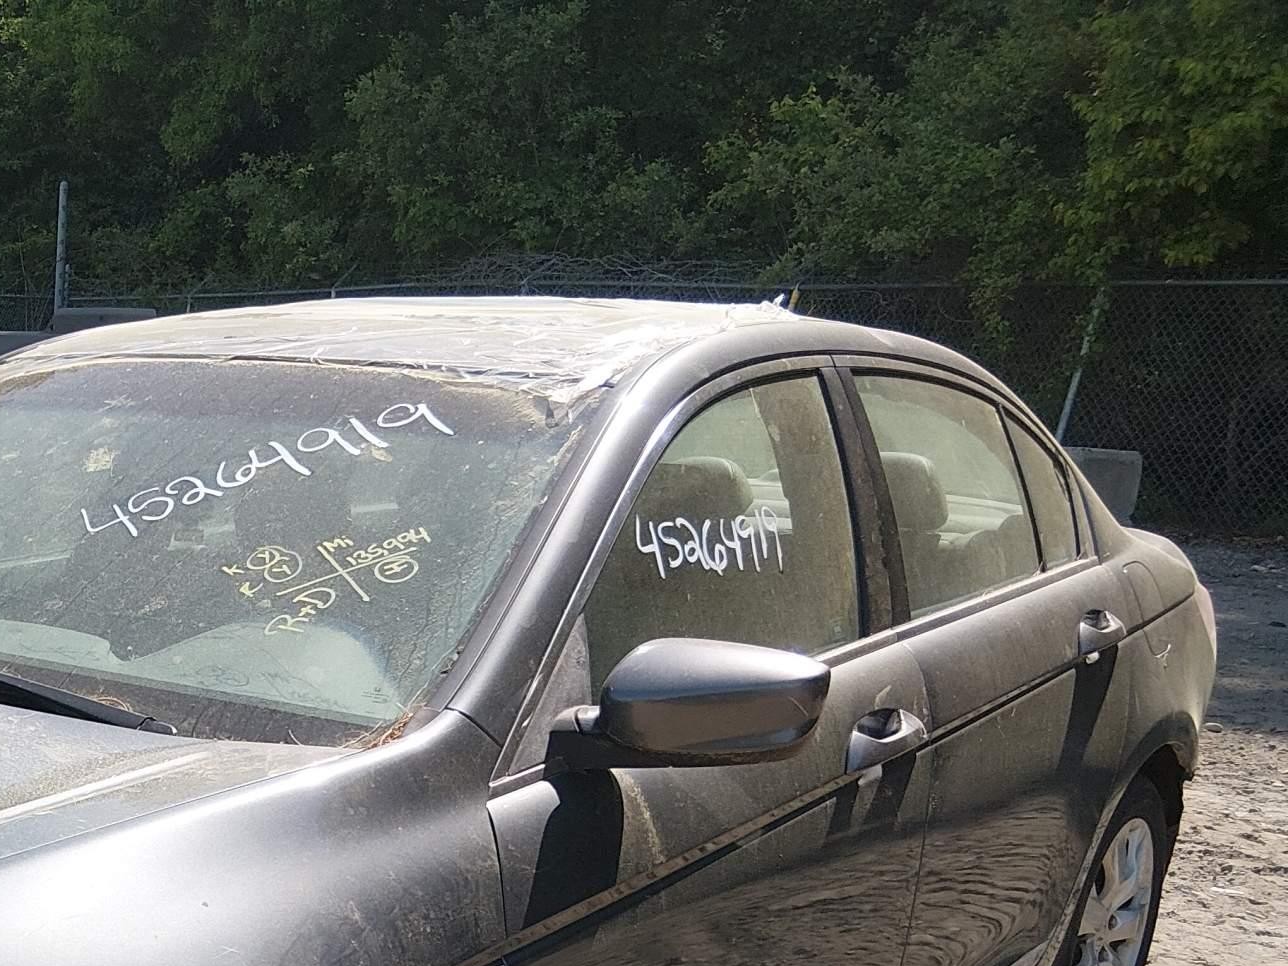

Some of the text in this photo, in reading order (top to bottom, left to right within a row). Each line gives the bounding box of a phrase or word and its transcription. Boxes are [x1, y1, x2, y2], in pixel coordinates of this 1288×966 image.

[81, 403, 455, 537] 45264919
[346, 527, 432, 566] 135,994
[636, 506, 784, 580] 45264919
